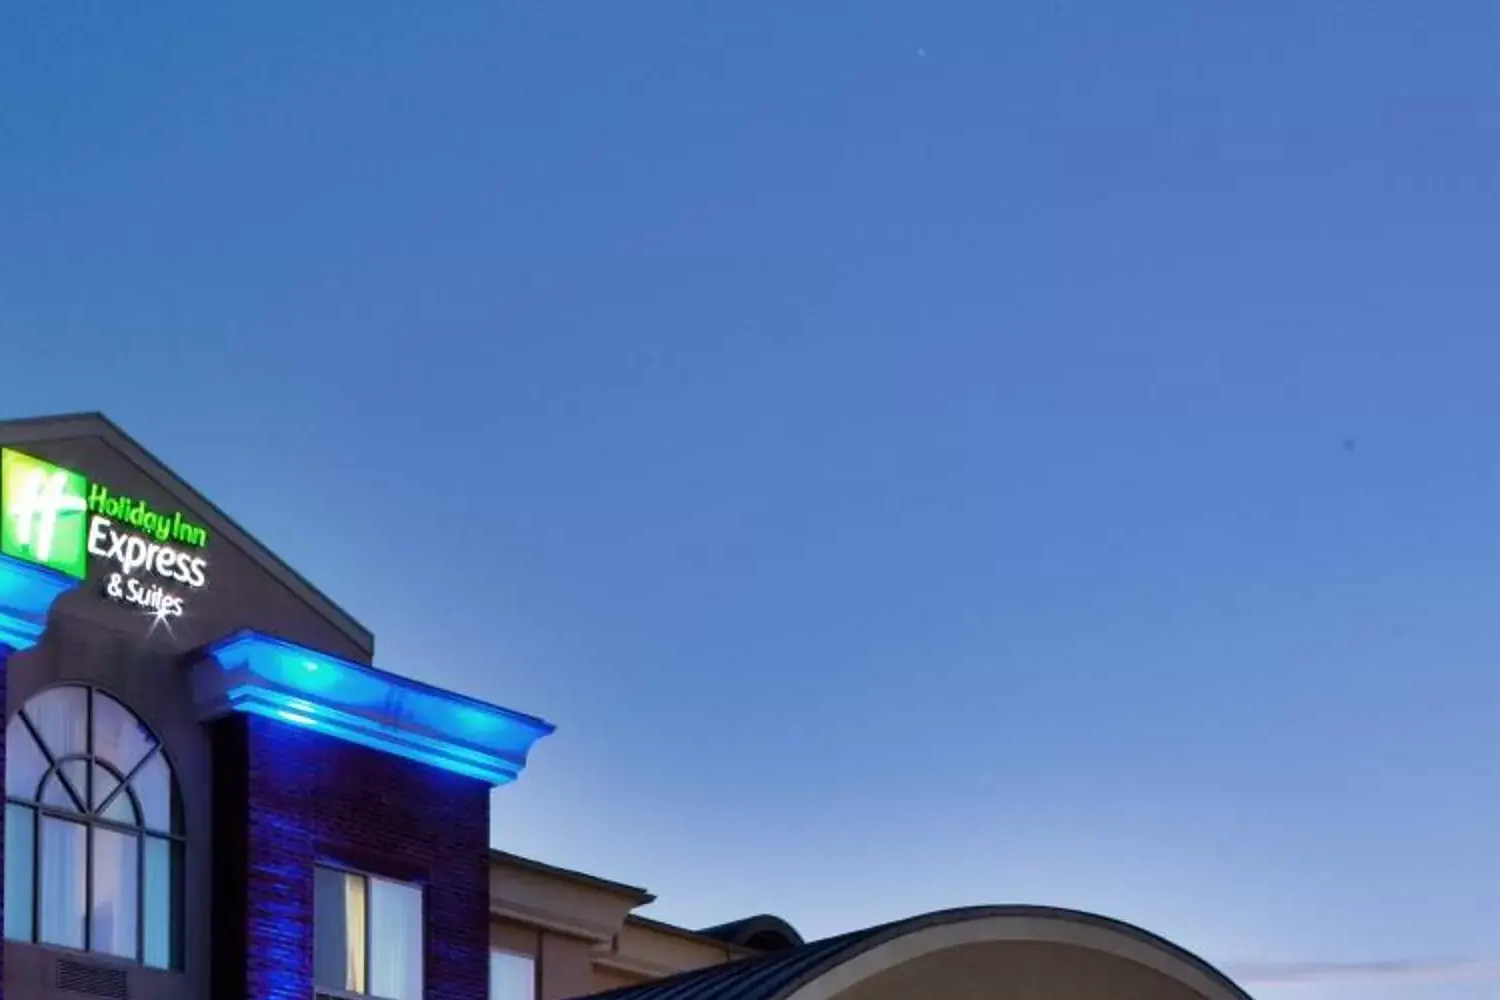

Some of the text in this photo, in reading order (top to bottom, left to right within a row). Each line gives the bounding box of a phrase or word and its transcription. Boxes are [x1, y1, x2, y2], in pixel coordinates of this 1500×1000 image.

[89, 484, 207, 547] Holiday Inn
[88, 515, 207, 587] Express
[107, 573, 184, 616] & Suites
